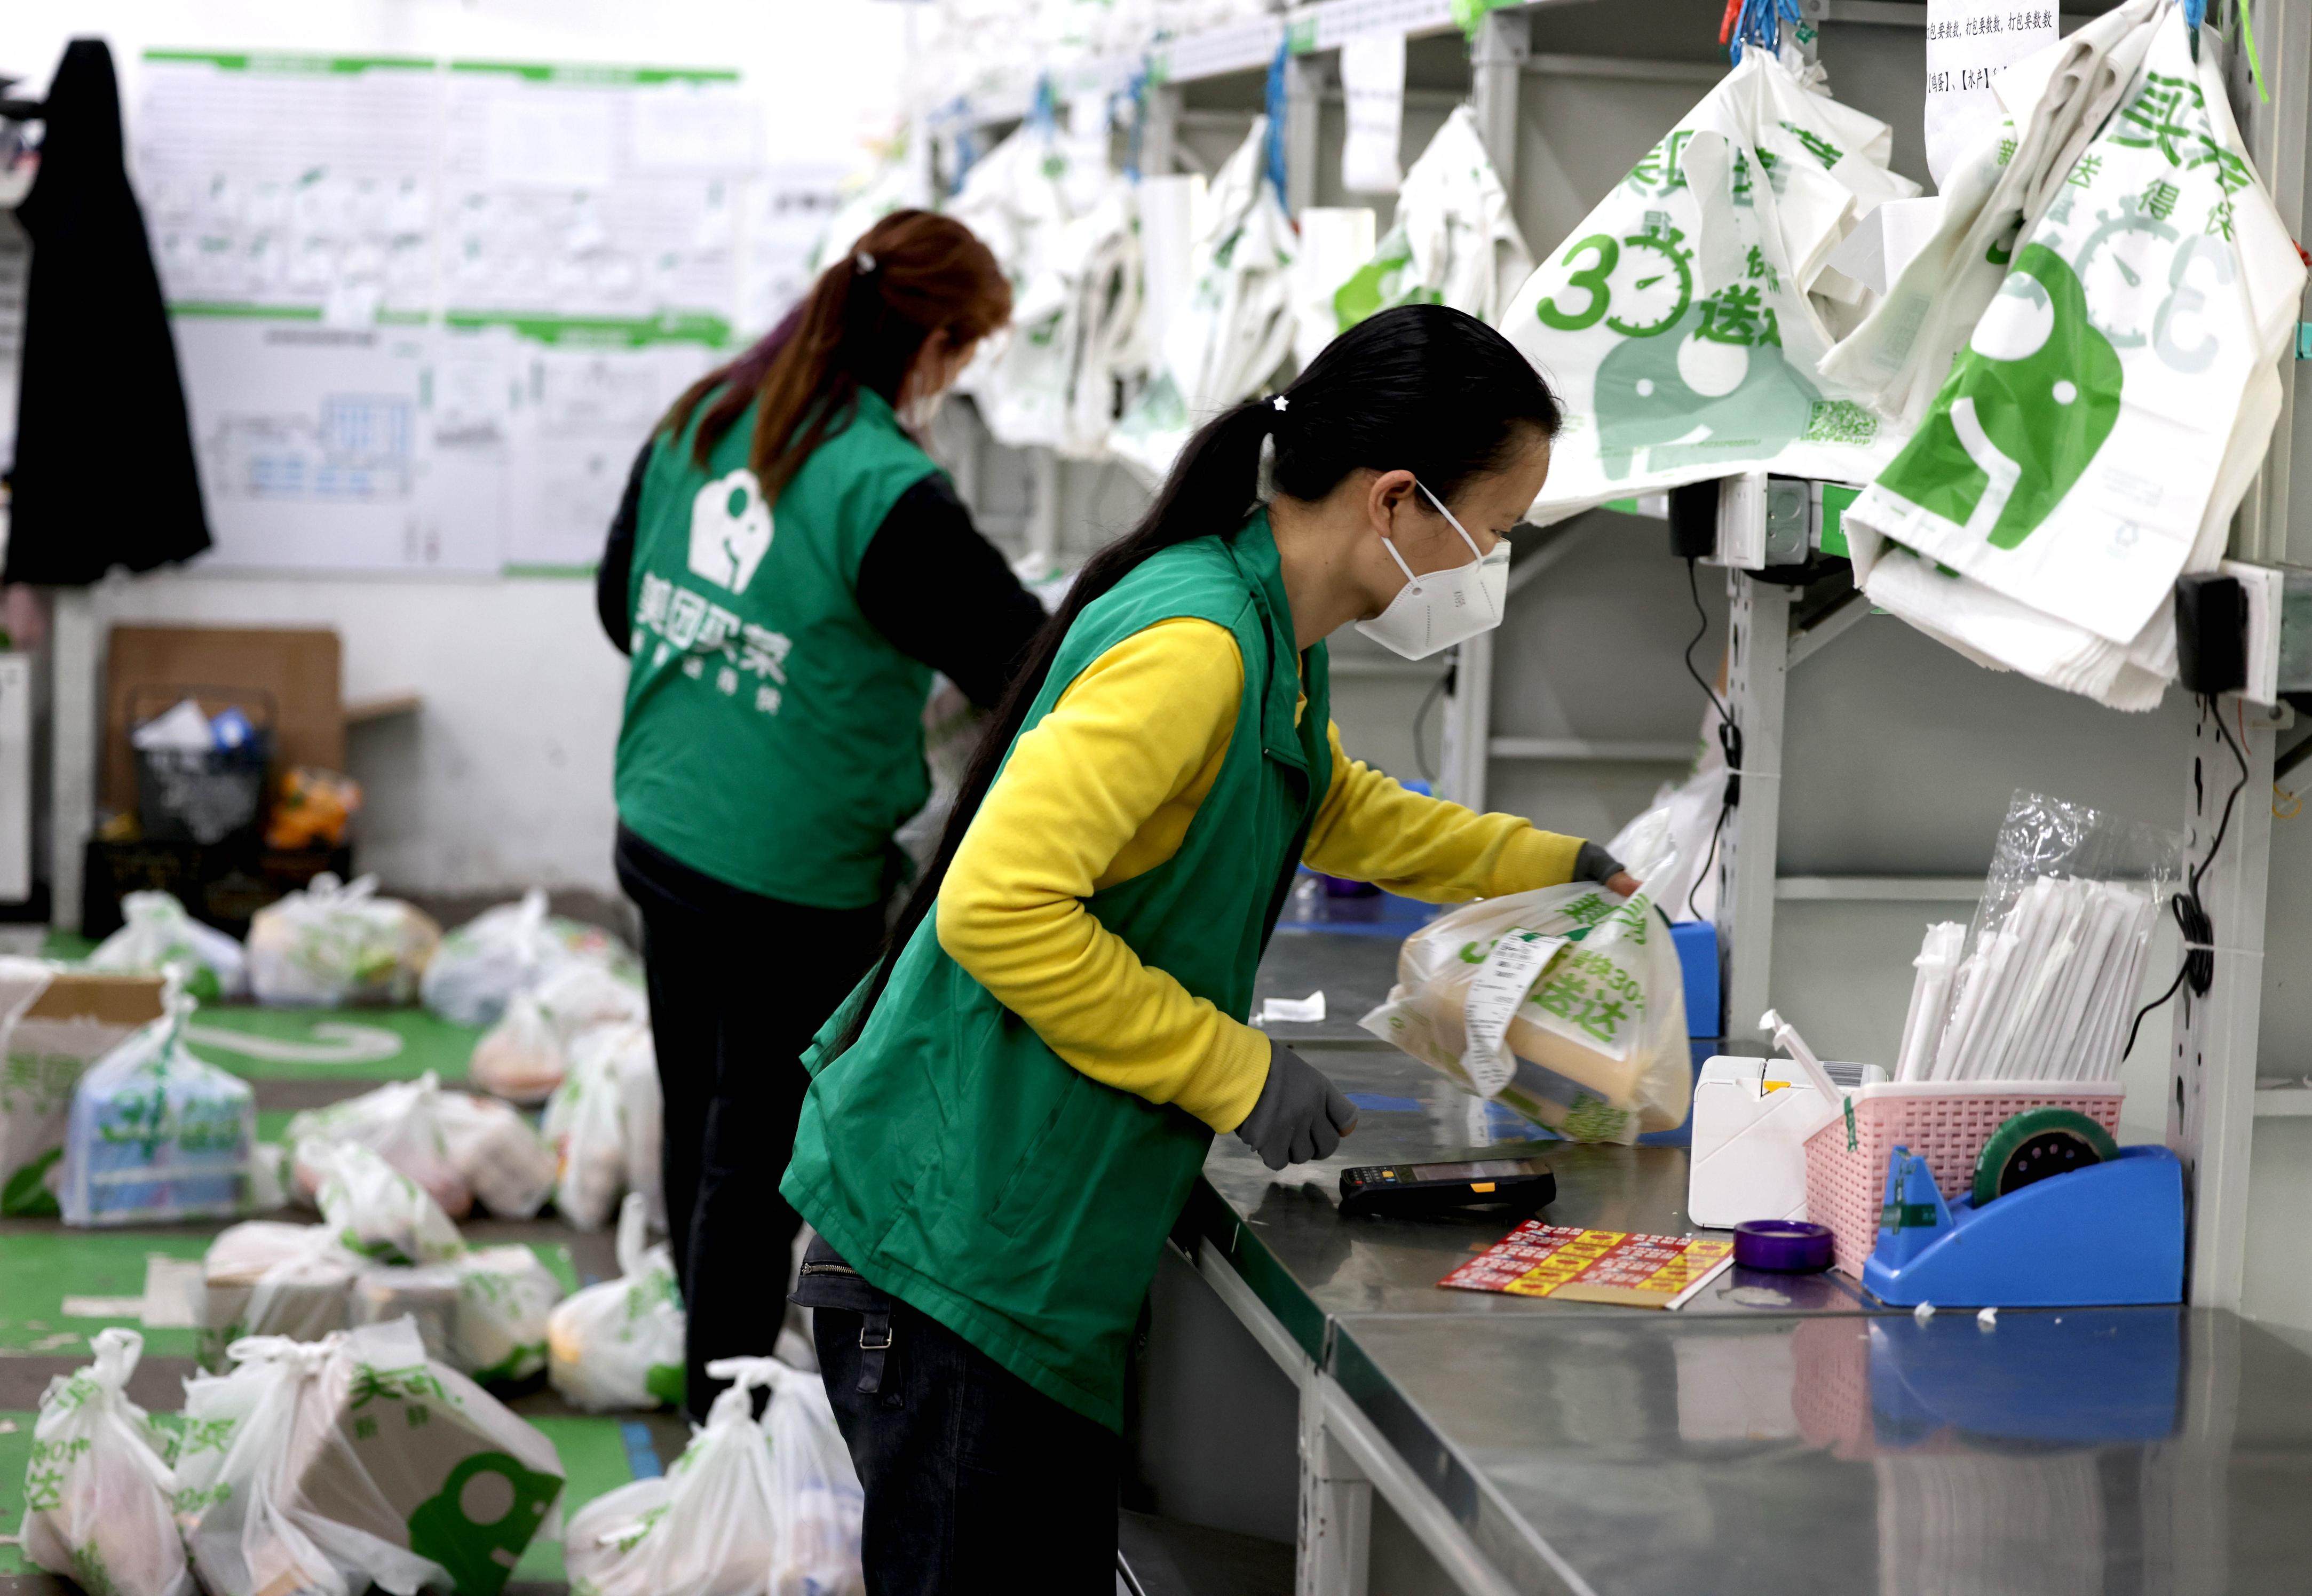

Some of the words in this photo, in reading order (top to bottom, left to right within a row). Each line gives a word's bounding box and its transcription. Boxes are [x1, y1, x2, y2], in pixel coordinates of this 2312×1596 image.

[635, 570, 793, 686] 美团买菜
[1531, 973, 1628, 1043] 送达
